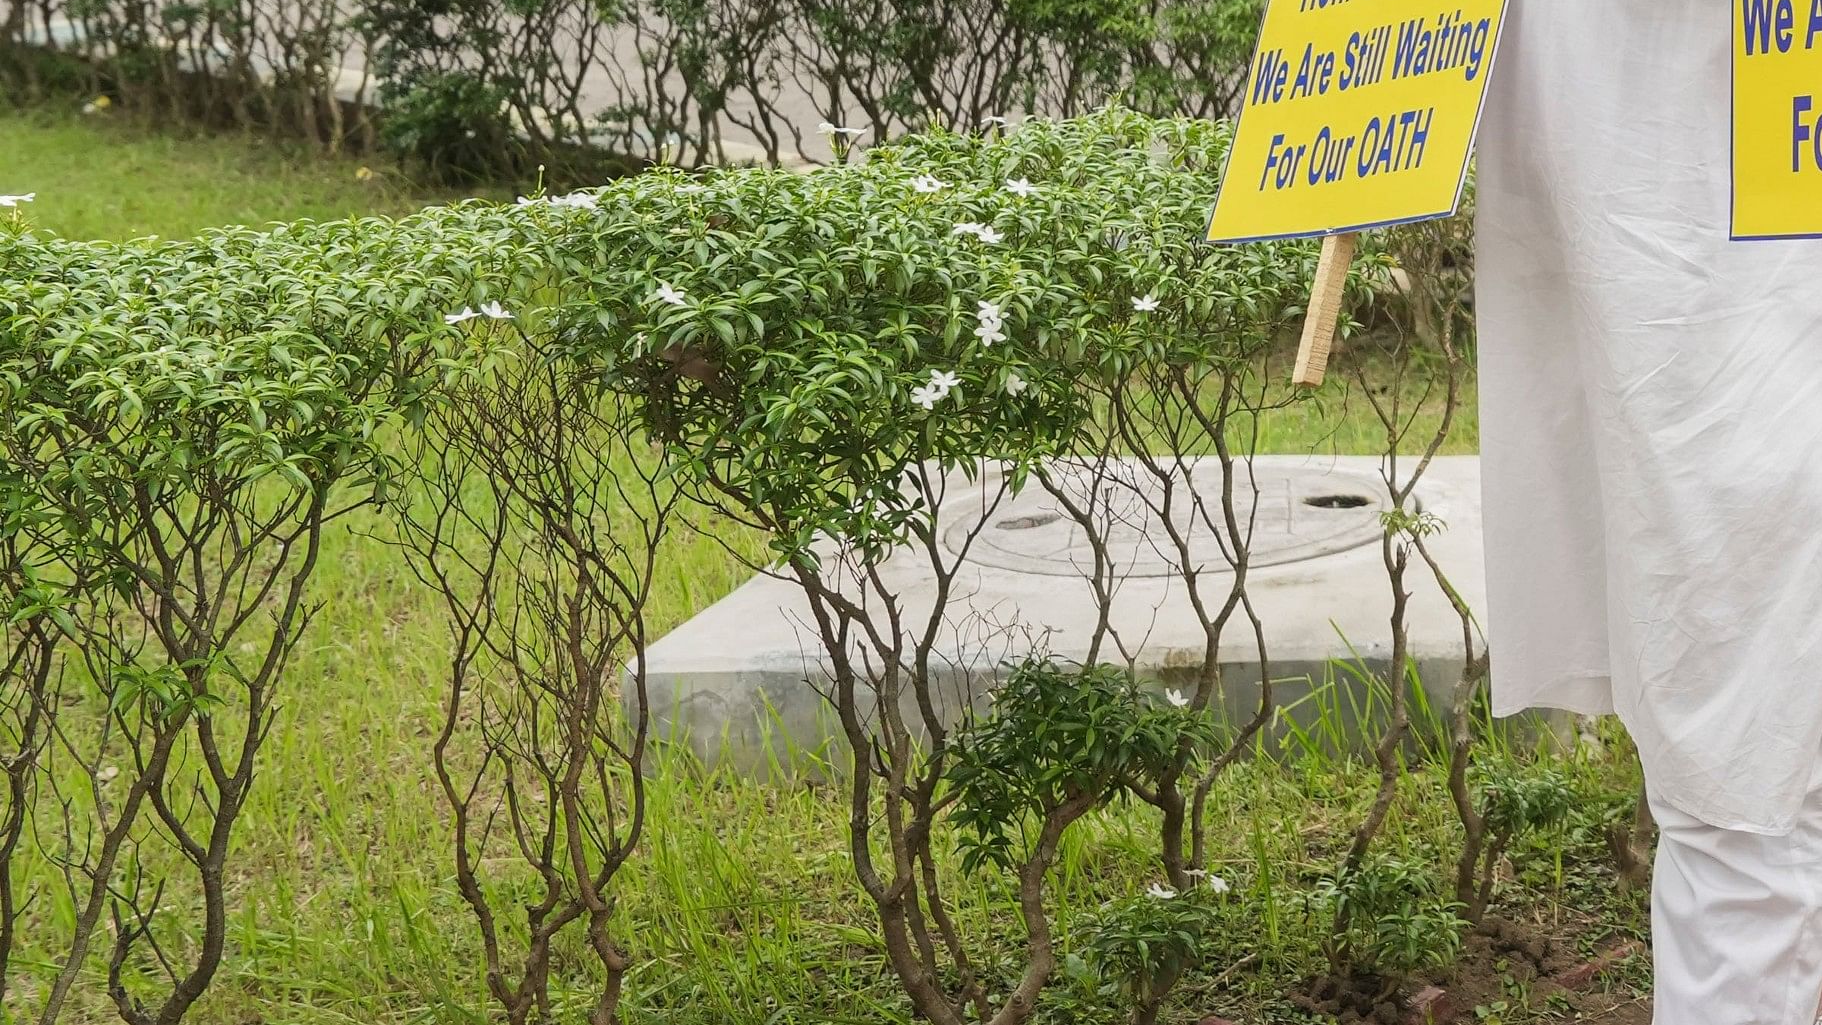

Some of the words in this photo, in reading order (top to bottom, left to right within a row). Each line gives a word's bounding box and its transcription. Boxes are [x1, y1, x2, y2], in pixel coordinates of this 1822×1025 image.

[1252, 48, 1289, 106] We
[1290, 42, 1335, 100] Are
[1338, 24, 1392, 92] Still
[1391, 9, 1491, 81] Waiting
[1259, 133, 1307, 192] For
[1307, 125, 1354, 187] Our
[1357, 107, 1434, 179] OATH
